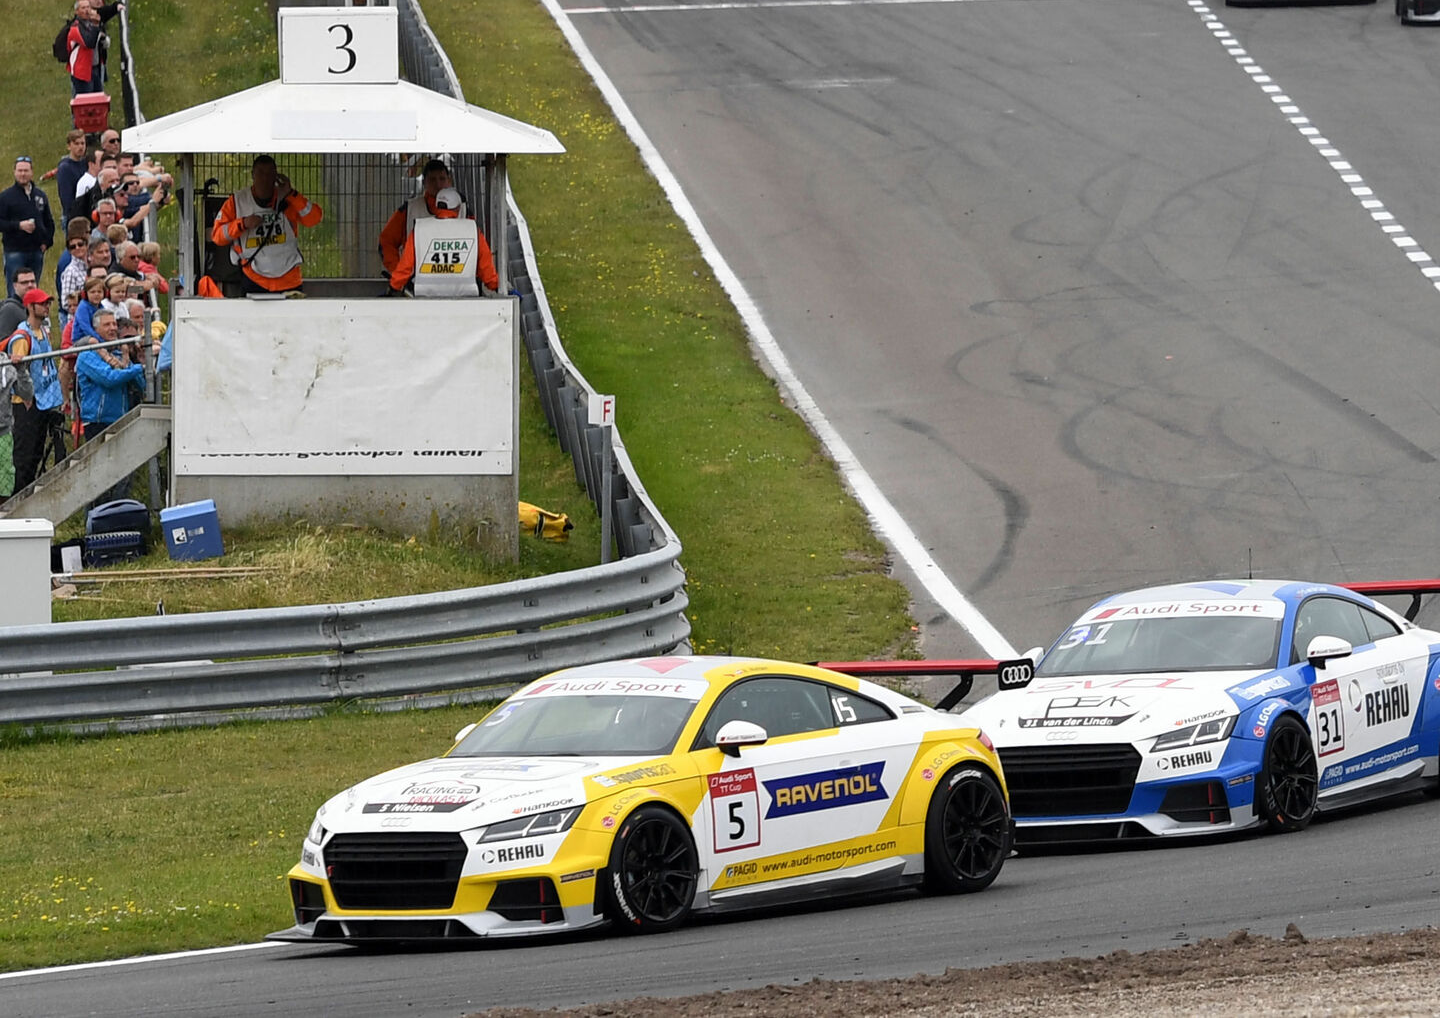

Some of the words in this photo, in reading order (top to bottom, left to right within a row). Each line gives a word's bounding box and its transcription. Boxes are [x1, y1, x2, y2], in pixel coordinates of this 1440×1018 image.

[327, 23, 358, 74] 3
[433, 241, 468, 251] DEKRA
[431, 253, 460, 264] 415
[430, 264, 455, 274] ADAC
[603, 401, 612, 423] F
[1123, 604, 1179, 616] Audi
[1187, 602, 1262, 615] Sport
[1058, 623, 1113, 650] 31
[553, 681, 605, 693] Audi
[610, 682, 687, 693] Sport
[832, 696, 857, 723] 15
[1364, 682, 1410, 728] REHAU
[1023, 719, 1037, 728] 31
[1043, 719, 1060, 727] van
[1063, 718, 1081, 726] der
[1084, 717, 1113, 727] Linde
[1318, 708, 1342, 746] 31
[1171, 750, 1213, 769] REHAU
[1345, 744, 1420, 775] www.audi-motorsport.com
[719, 775, 734, 785] Audi
[734, 772, 753, 783] Sport
[408, 785, 456, 795] RACING
[720, 785, 730, 793] TT
[730, 783, 742, 793] Cup
[776, 775, 877, 807] RAVENOL
[378, 804, 388, 813] 5
[392, 803, 434, 813] Nielsen
[728, 801, 745, 840] 5
[497, 844, 544, 862] REHAU
[733, 862, 757, 875] PAGID
[762, 839, 896, 873] www.audi-motorsport.com
